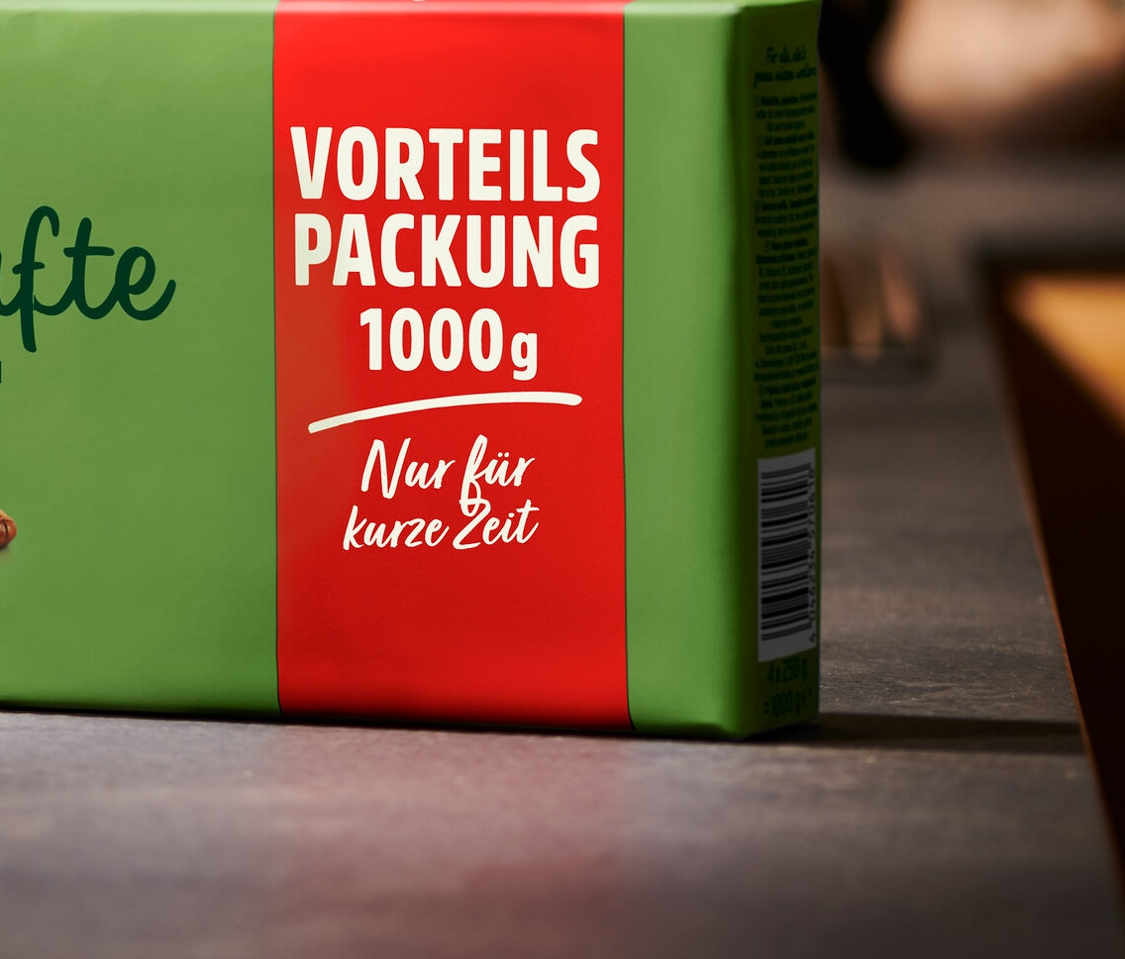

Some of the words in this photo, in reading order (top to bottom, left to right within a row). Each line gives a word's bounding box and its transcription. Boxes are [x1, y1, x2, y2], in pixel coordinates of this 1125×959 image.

[290, 125, 601, 203] VORTEILS
[294, 212, 600, 289] PACKUNG
[361, 437, 456, 500] Nur
[460, 434, 536, 517] für
[342, 504, 451, 551] kurze
[452, 497, 541, 551] Zeit
